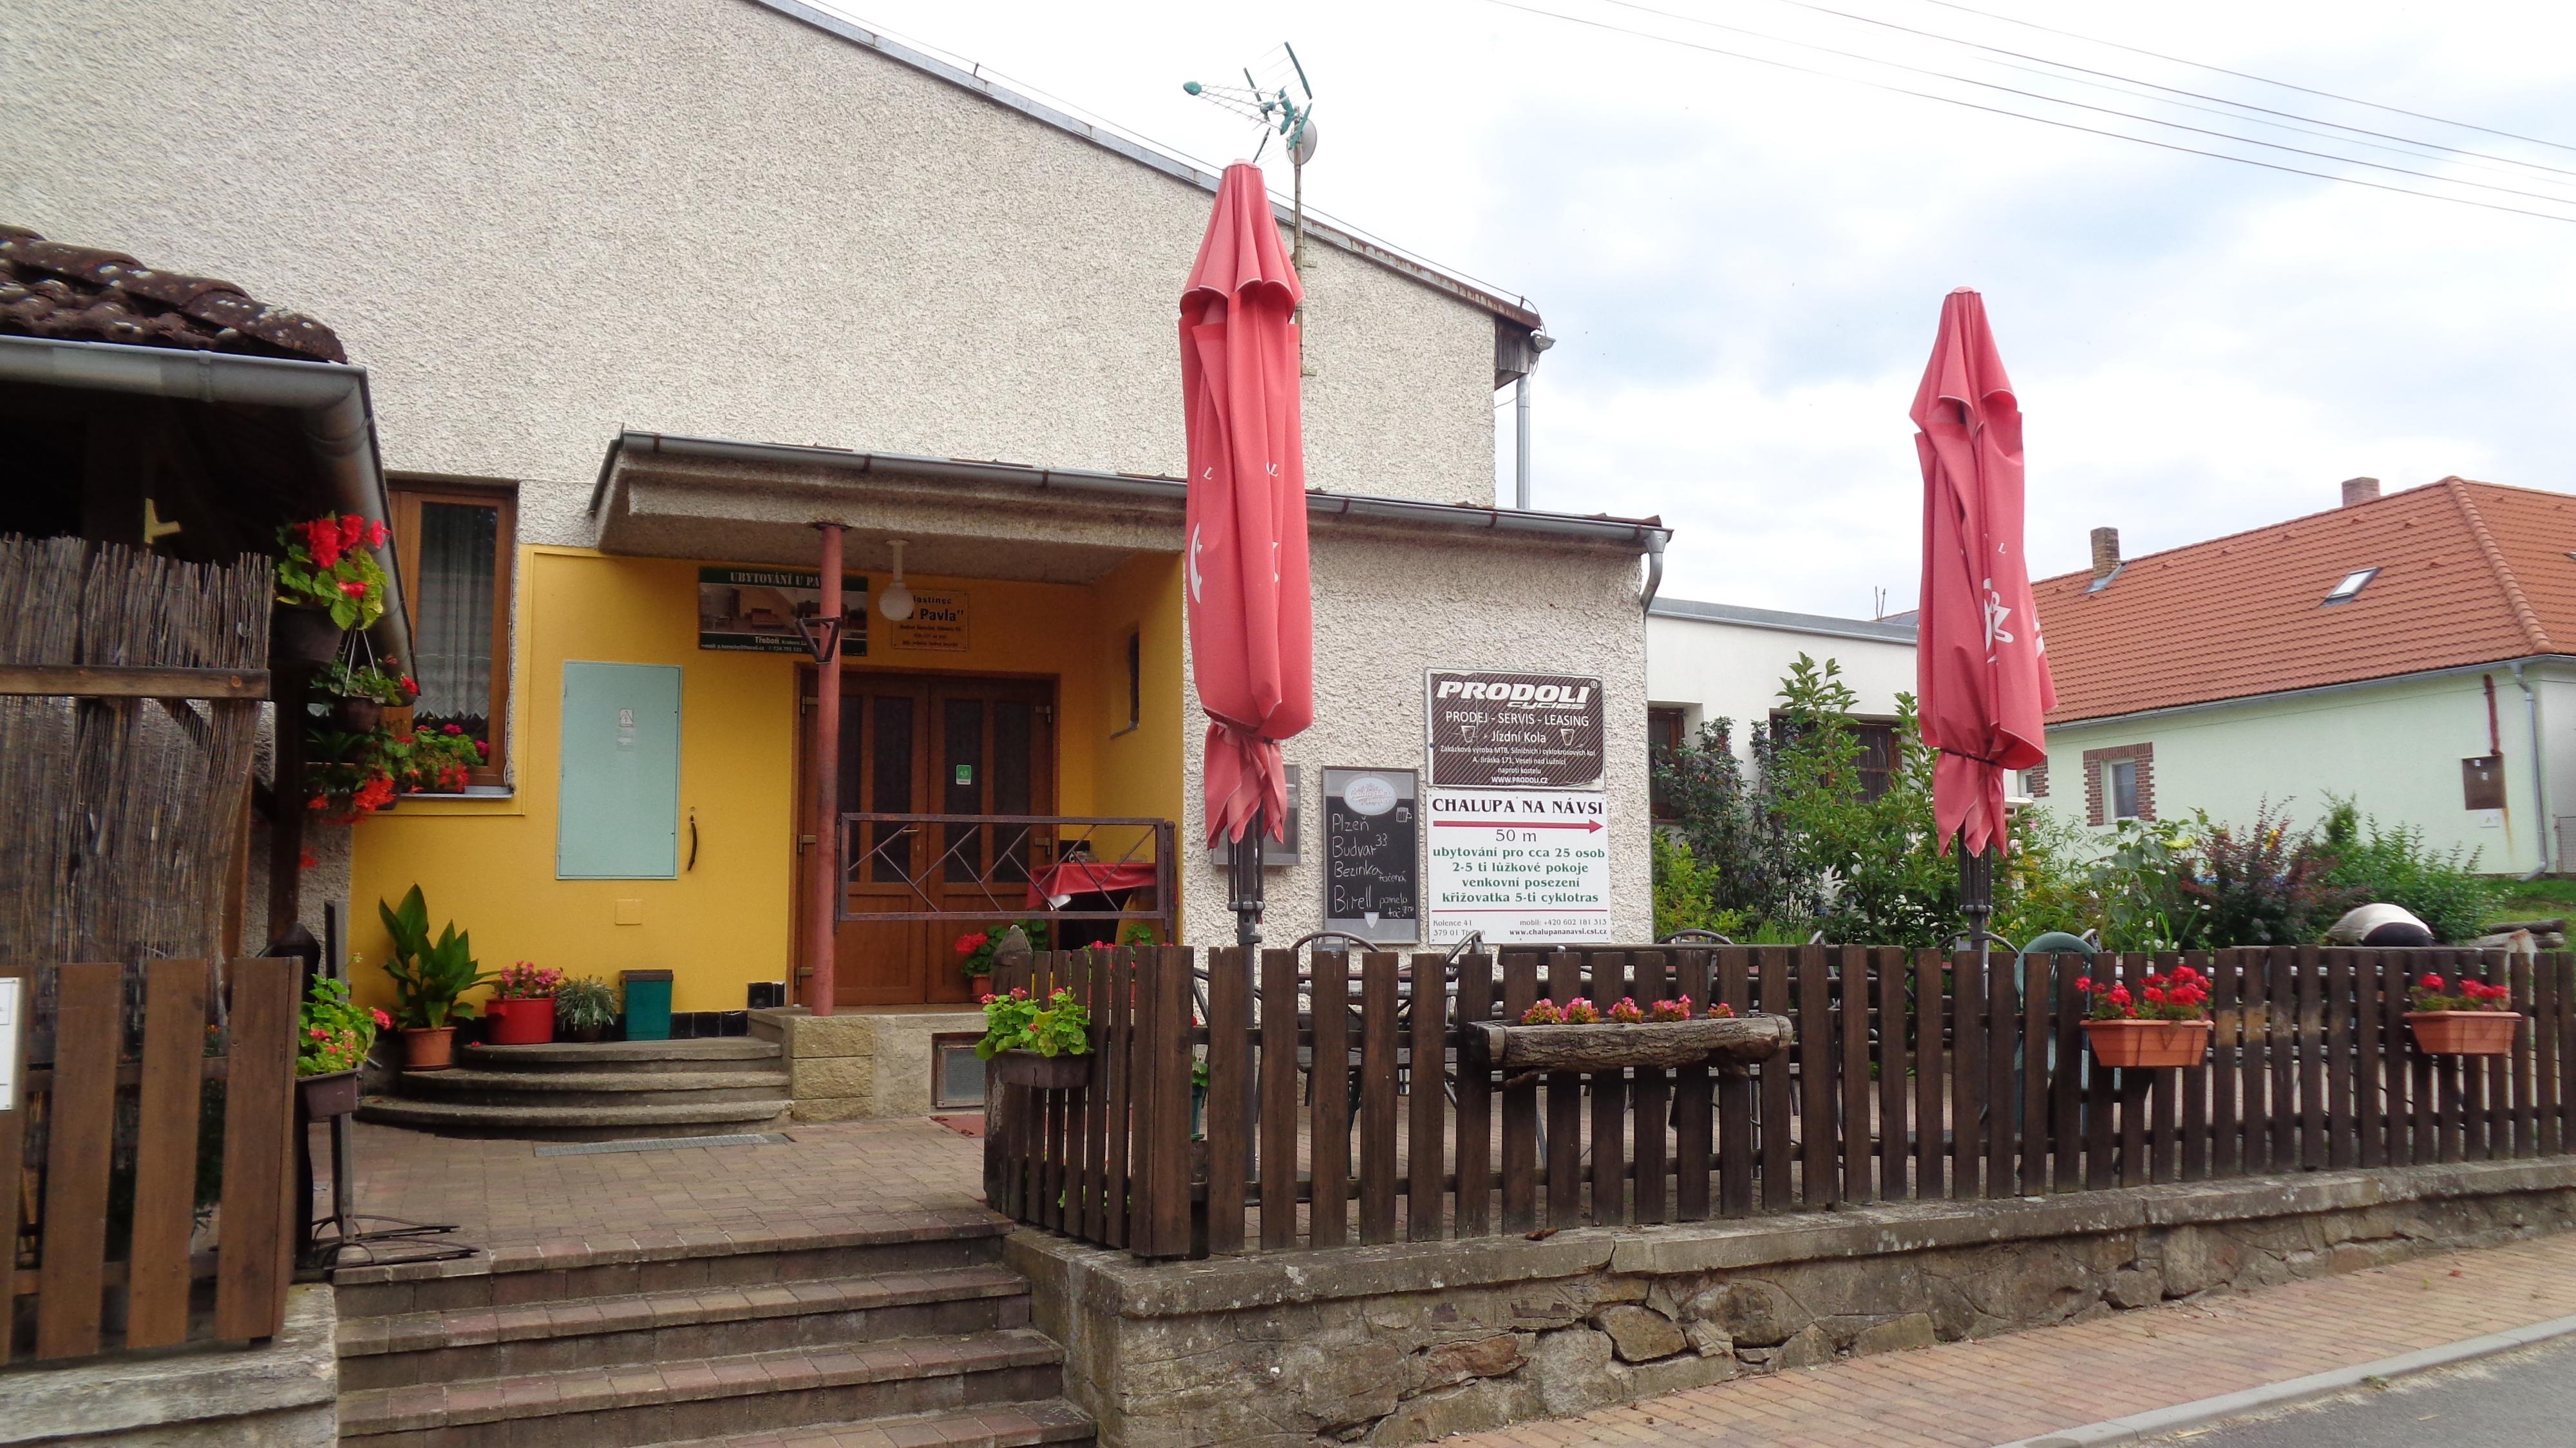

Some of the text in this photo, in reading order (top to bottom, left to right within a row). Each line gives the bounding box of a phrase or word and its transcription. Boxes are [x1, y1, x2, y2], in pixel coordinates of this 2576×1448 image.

[730, 572, 791, 585] UBYTOVÁNÍ
[796, 576, 802, 586] U
[1437, 681, 1589, 703] PRODOLI
[1446, 711, 1488, 723] PRODEJ
[1498, 712, 1535, 724] SERVIS
[1544, 714, 1589, 727] LEASING
[1491, 730, 1546, 743] Jízdní Kola
[1491, 776, 1548, 784] WWW.PRODOLI.CZ
[1432, 797, 1603, 815] CHALUPA NA NÁVSI
[1332, 813, 1368, 833] Plzeň
[1495, 830, 1537, 843] 50 m
[1332, 833, 1387, 858] Budvar 33
[1433, 846, 1497, 859] ubytování
[1502, 849, 1524, 860] pro
[1555, 848, 1570, 857] 25
[1575, 848, 1605, 858] osob
[1334, 859, 1383, 878] Bezinka
[1452, 862, 1588, 875] 2-5 ti lůžkové pokoje
[1462, 877, 1580, 890] venkovní posezení
[1334, 884, 1371, 913] Birell
[1443, 892, 1598, 905] křižovatka 5-ti cyklotras
